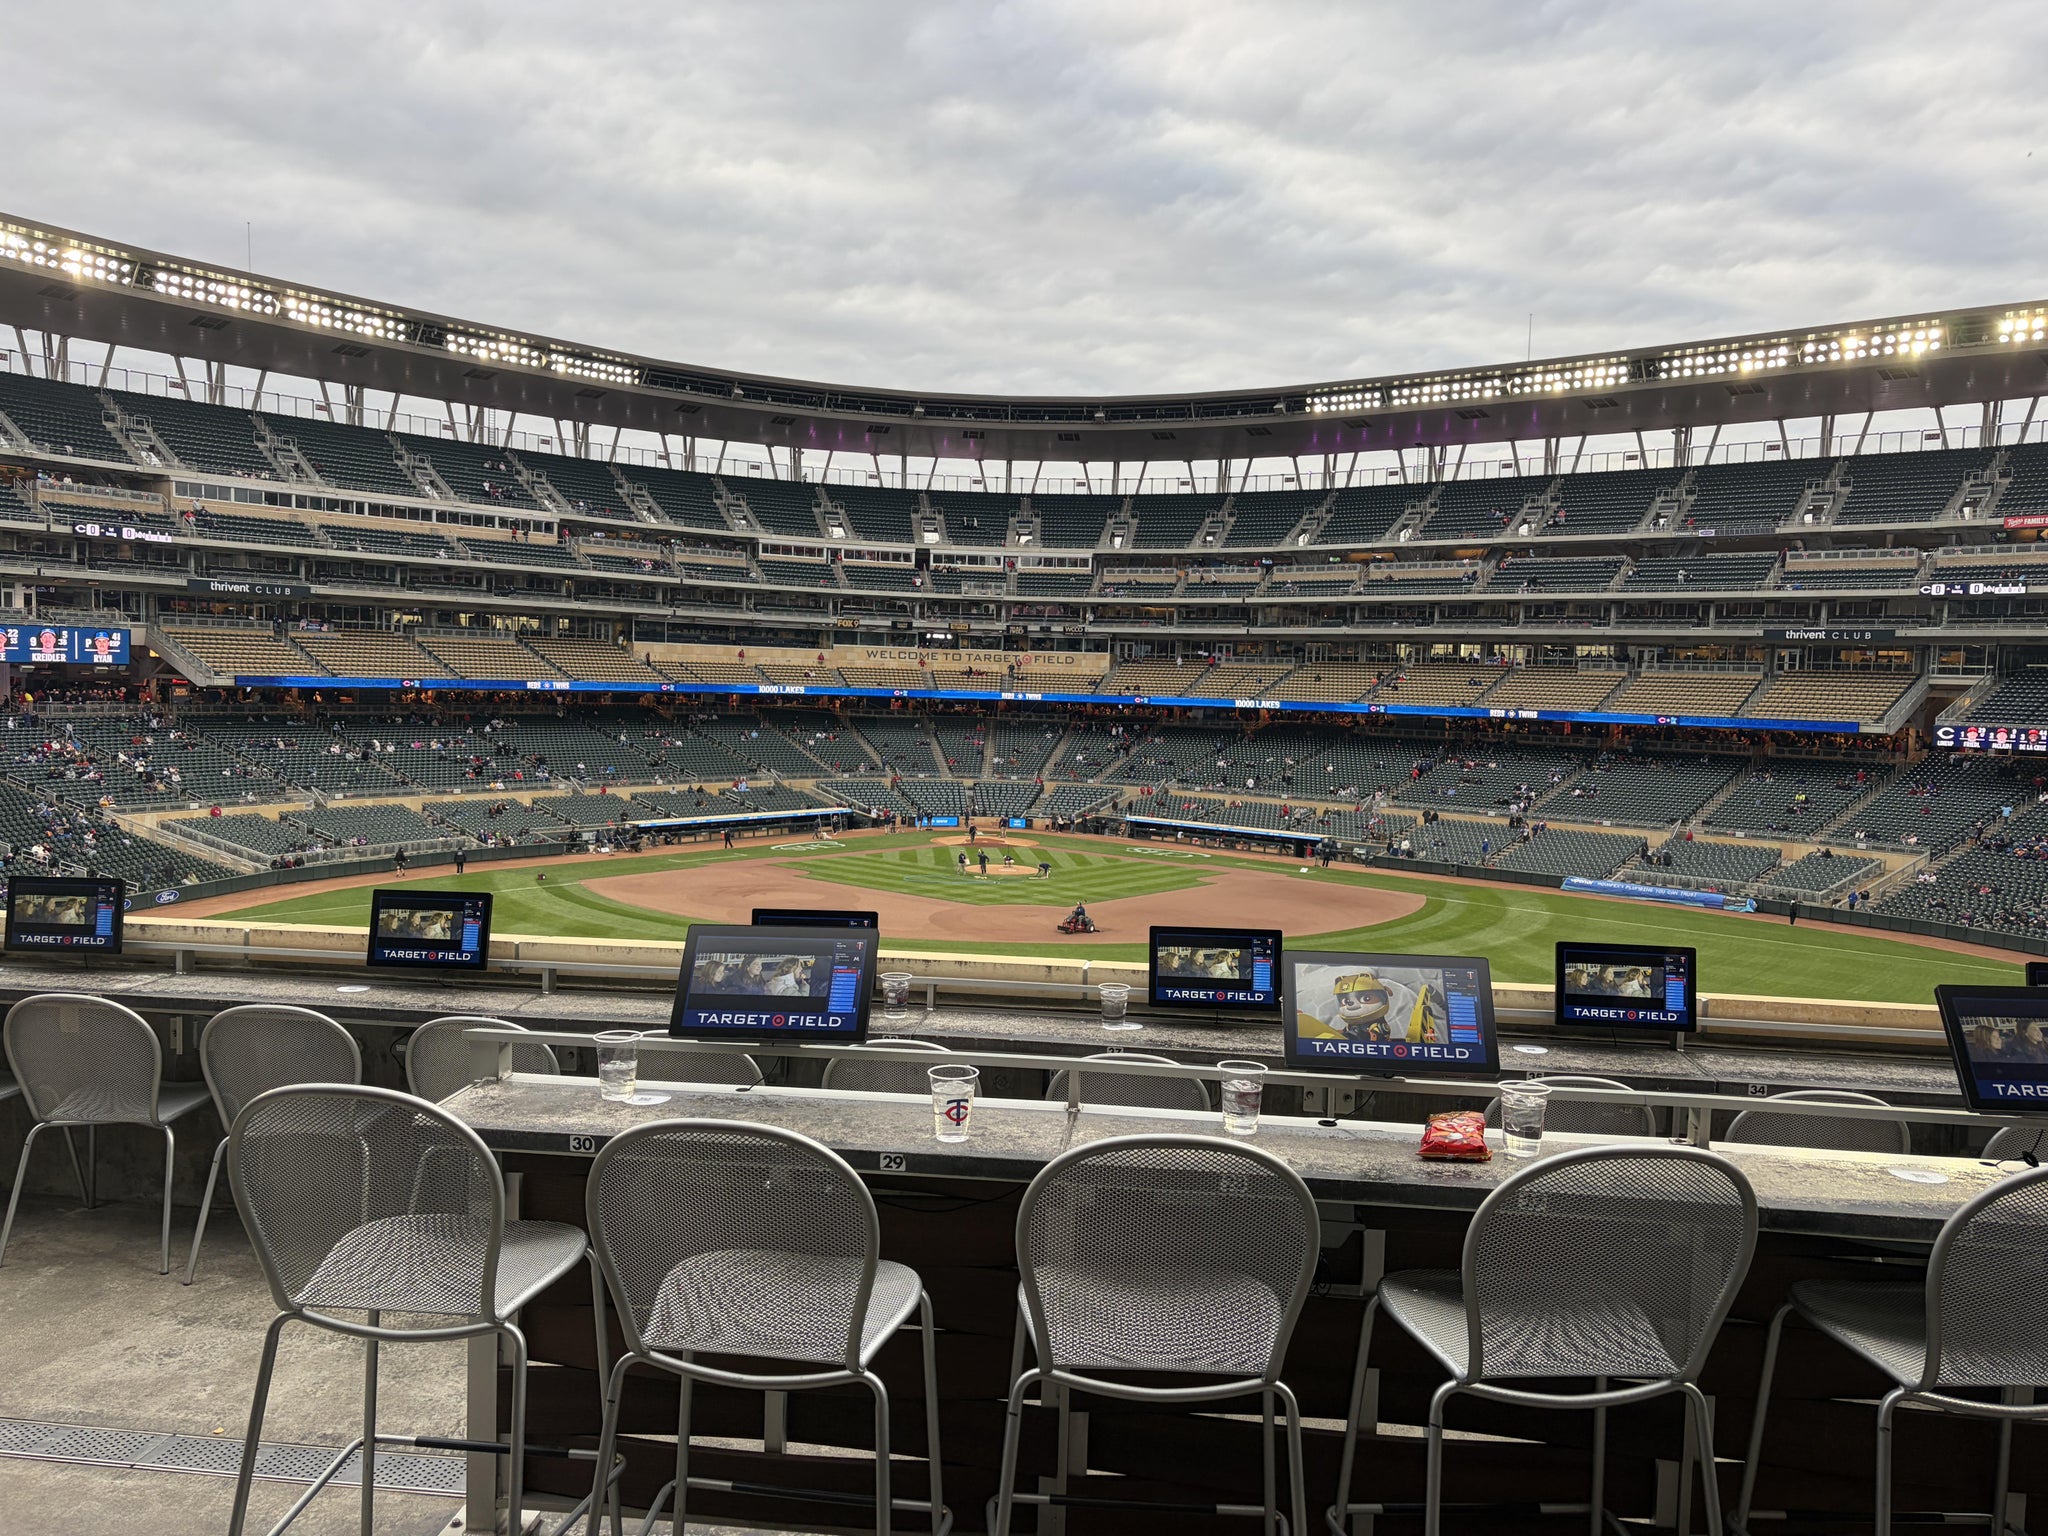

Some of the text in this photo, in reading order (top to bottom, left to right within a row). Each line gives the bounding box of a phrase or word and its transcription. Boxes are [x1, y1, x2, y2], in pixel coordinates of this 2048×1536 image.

[2024, 516, 2044, 525] FAMILY
[210, 581, 291, 595] thrivent CLUB
[837, 620, 854, 628] FOX
[7, 629, 18, 637] 22
[1785, 629, 1872, 640] thrivent CLUB
[85, 638, 92, 648] P
[31, 652, 67, 662] KREIDLER
[93, 654, 113, 663] RYAN
[866, 650, 1075, 665] WELCOME TO TARGET FIELD
[758, 685, 805, 694] 10000 LAKES
[1235, 699, 1280, 709] 10000 LAKES
[1518, 710, 1538, 719] TWINS
[160, 892, 175, 901] Ford
[1680, 889, 1697, 898] TRUST
[19, 934, 105, 945] TARGET FIELD
[383, 949, 471, 961] TARGET FIELD
[1165, 989, 1264, 1001] TARGET FIELD
[1573, 1007, 1678, 1021] TARGET FIELD
[697, 1012, 842, 1027] TARGET FIELD
[1311, 1041, 1470, 1059] TARGET FIELD
[1750, 1085, 1766, 1095] 34
[1992, 1083, 2048, 1097] TARG
[571, 1137, 593, 1151] 30
[882, 1155, 904, 1169] 29
